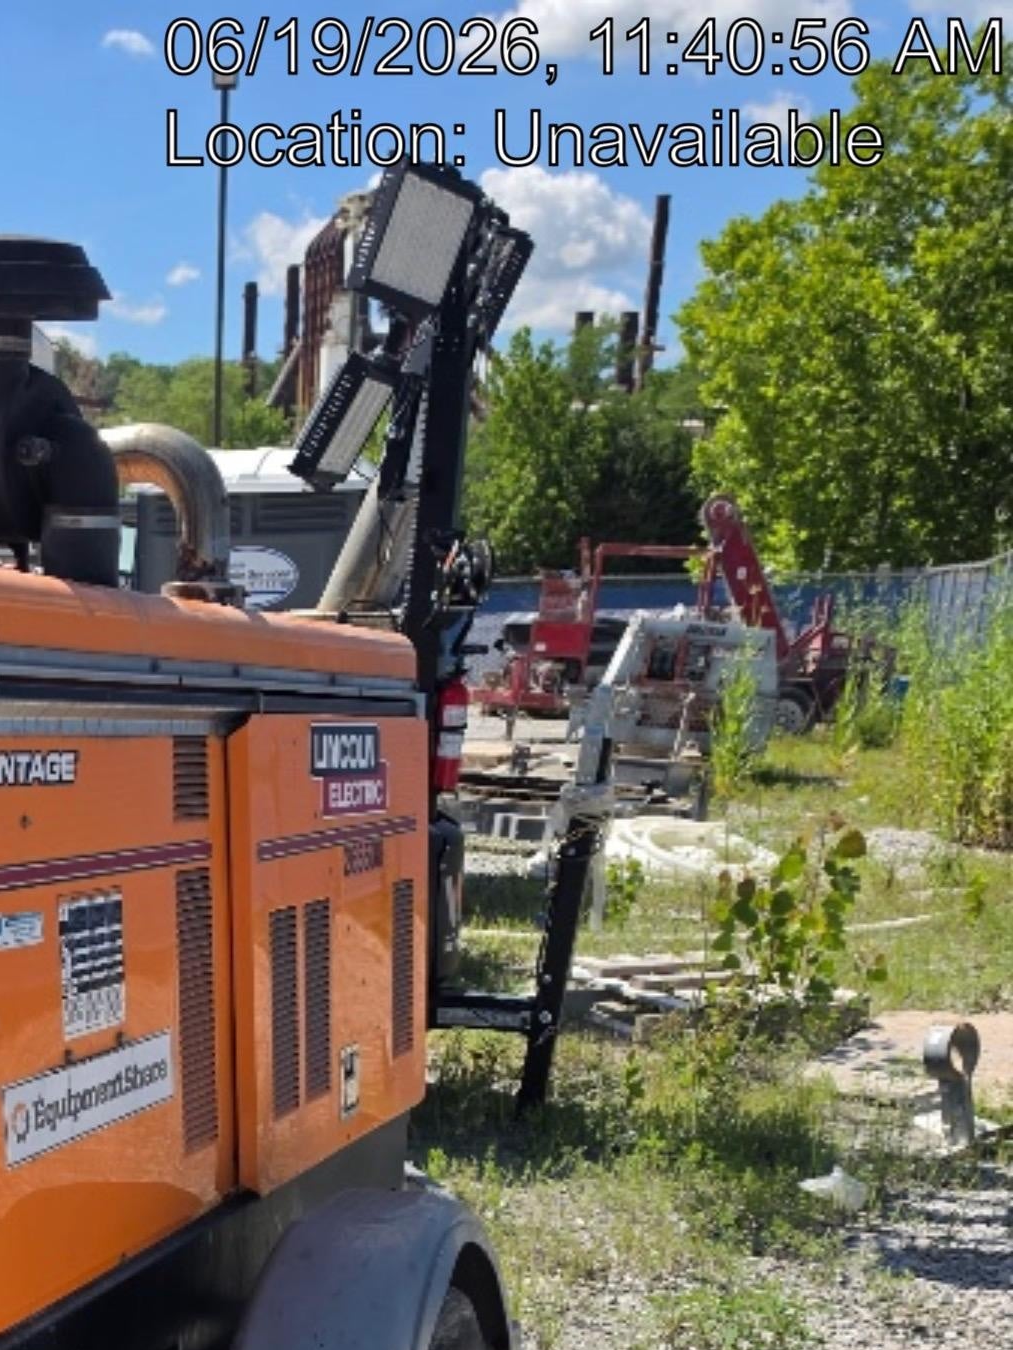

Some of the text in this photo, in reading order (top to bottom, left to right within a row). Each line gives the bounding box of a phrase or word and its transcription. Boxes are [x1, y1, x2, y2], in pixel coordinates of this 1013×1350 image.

[314, 734, 376, 769] LINCOLN
[328, 779, 384, 809] ELECTRIC
[33, 1058, 168, 1132] EquipmentShare
